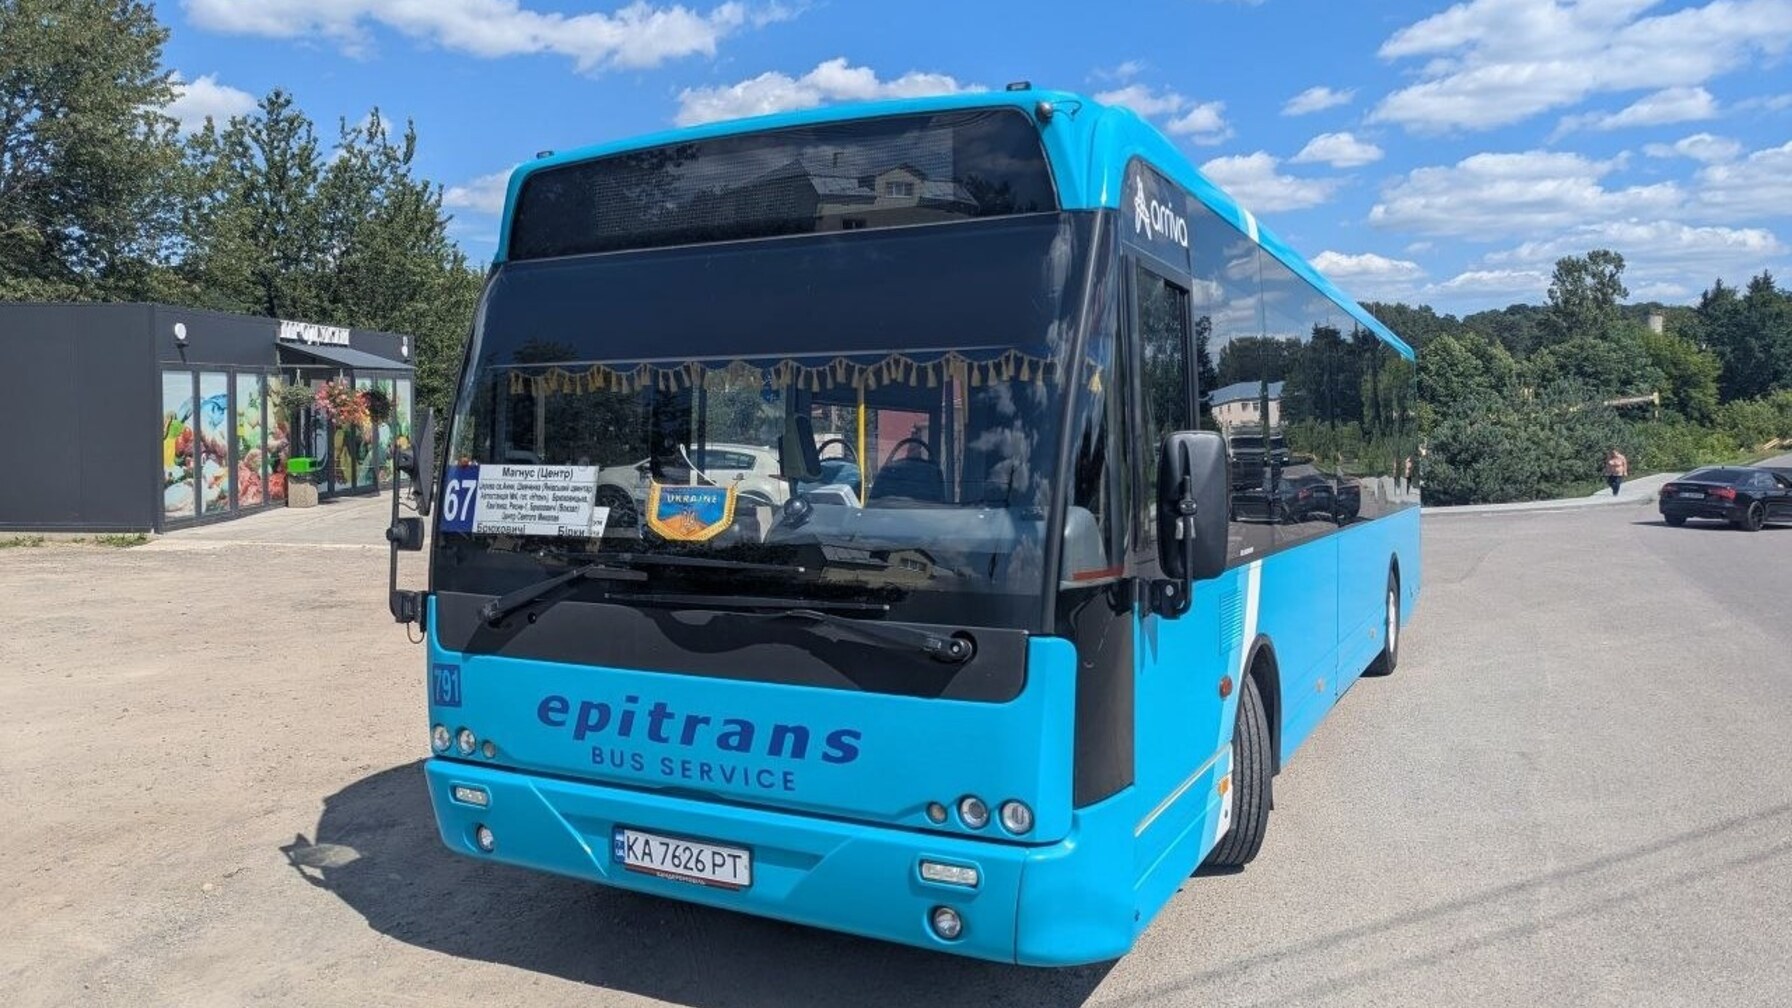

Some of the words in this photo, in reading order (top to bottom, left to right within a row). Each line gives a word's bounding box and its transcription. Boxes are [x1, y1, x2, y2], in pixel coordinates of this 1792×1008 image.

[1150, 199, 1189, 247] arriva
[502, 467, 536, 480] Магнус
[537, 467, 574, 481] (Центр)
[443, 479, 477, 522] 67
[667, 493, 718, 504] UKRAINE
[433, 669, 459, 702] 791
[536, 693, 862, 764] epitrans
[591, 745, 645, 771] BUS
[660, 757, 796, 791] SERVICE
